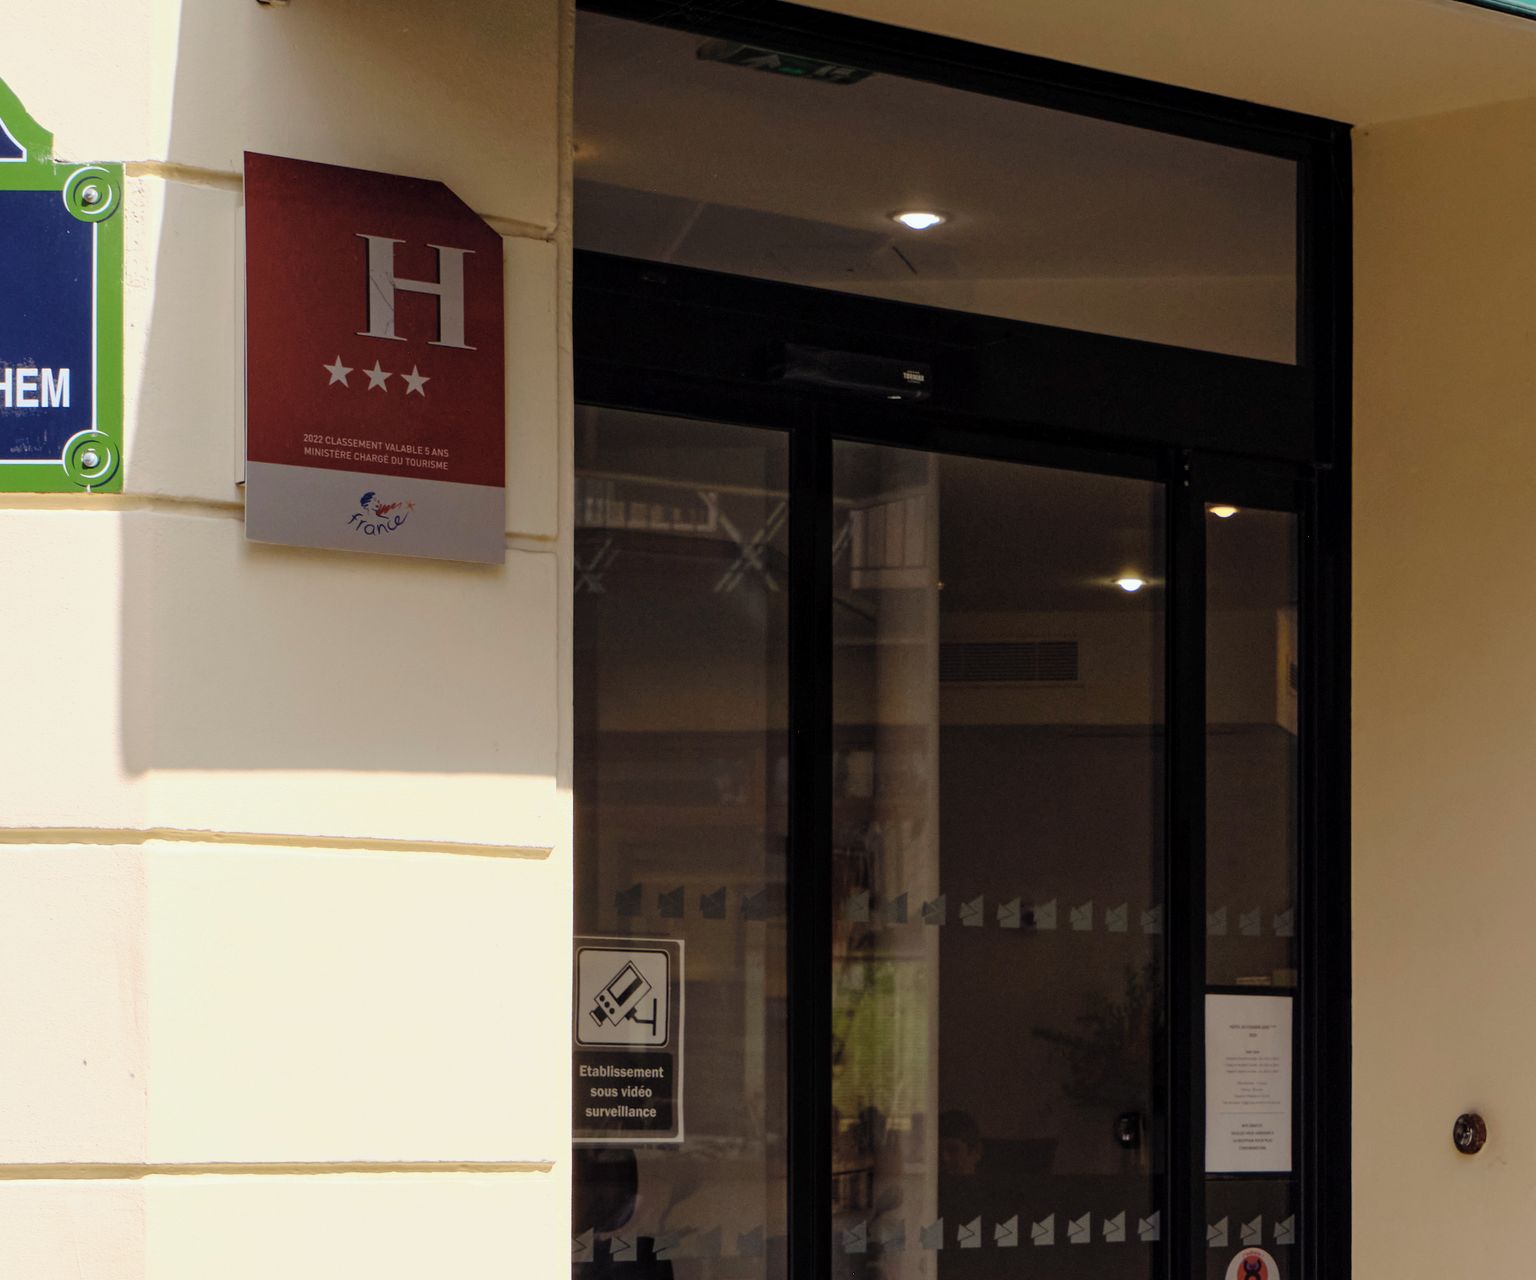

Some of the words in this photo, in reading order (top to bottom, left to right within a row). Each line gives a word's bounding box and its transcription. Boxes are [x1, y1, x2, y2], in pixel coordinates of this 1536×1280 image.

[355, 233, 477, 351] H
[0, 367, 70, 408] HEM
[303, 433, 323, 443] 2022
[325, 436, 382, 450] CLASSEMENT
[385, 442, 423, 455] VALABLE
[425, 446, 430, 456] 5
[431, 447, 449, 458] ANS
[304, 446, 351, 459] MINISTÈRE
[353, 452, 389, 464] CHARGÉ
[391, 455, 403, 465] DU
[405, 457, 449, 471] TOURISME
[348, 511, 408, 536] france
[579, 1065, 664, 1079] Etablissement
[590, 1085, 618, 1098] sous
[620, 1084, 653, 1098] vidéo
[585, 1105, 657, 1118] surveillance
